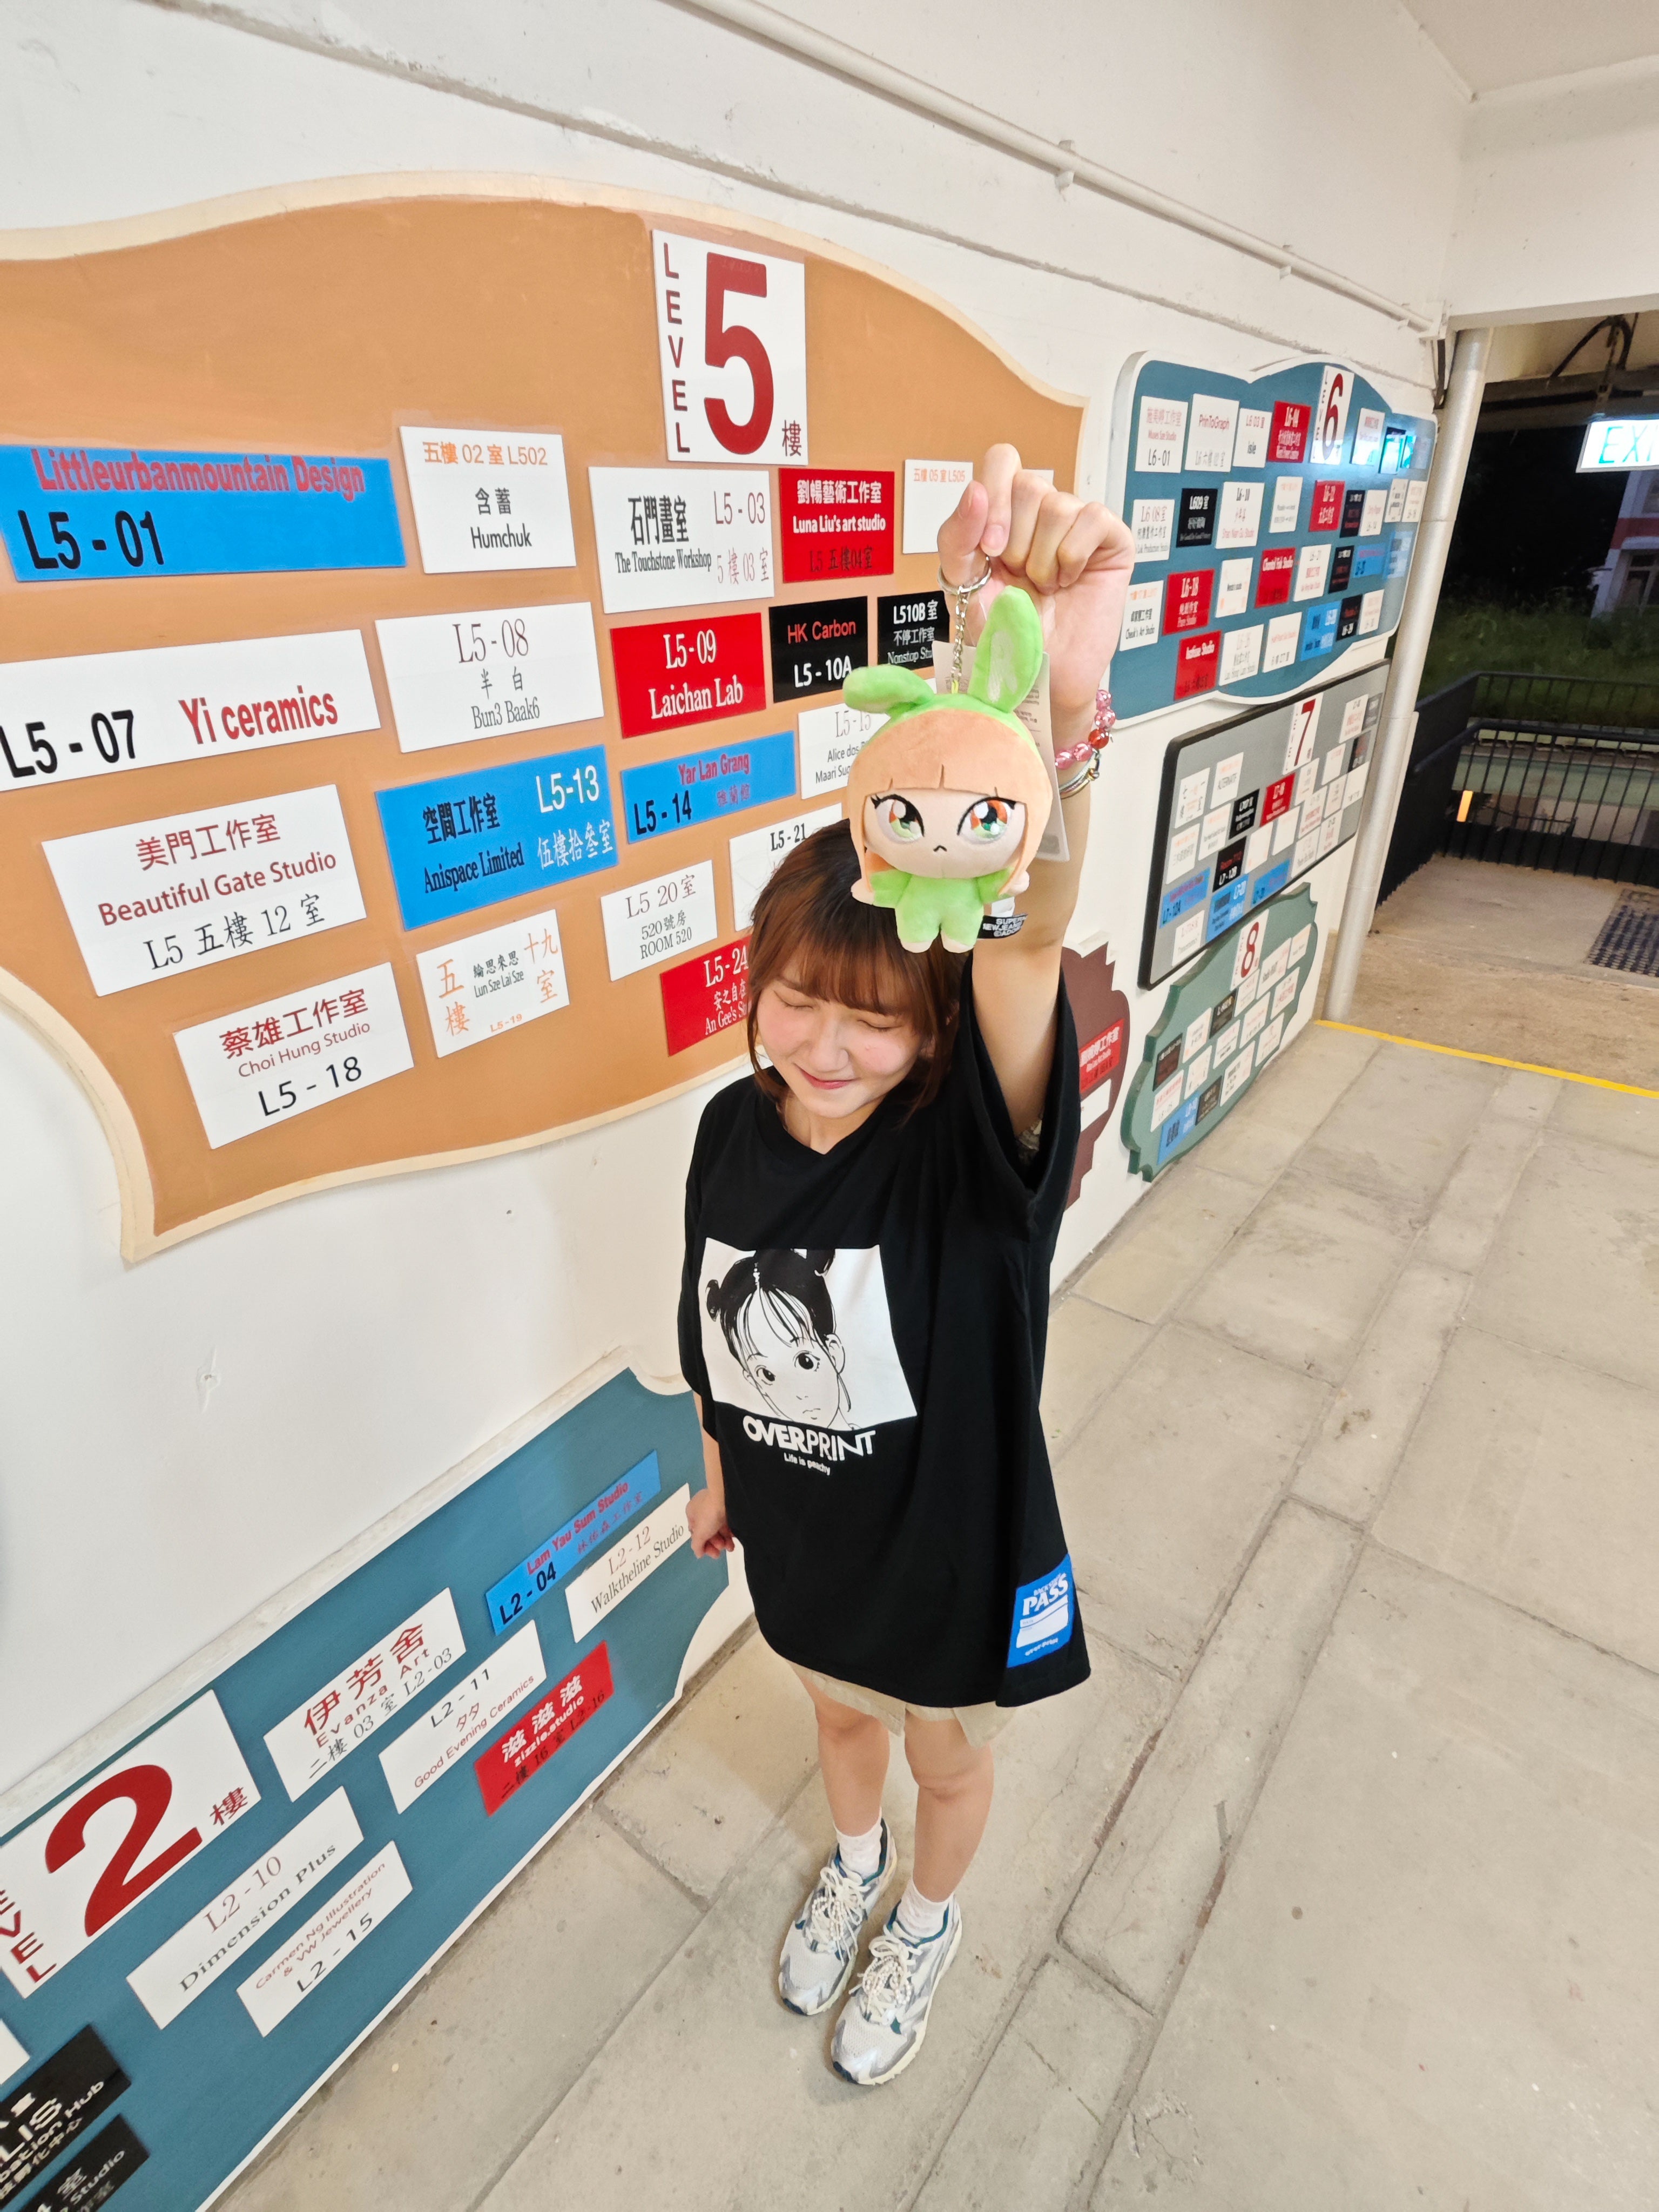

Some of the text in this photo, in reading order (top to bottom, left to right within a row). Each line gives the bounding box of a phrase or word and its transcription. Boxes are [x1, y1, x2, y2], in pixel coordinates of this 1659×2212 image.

[664, 242, 690, 453] LEVEL
[704, 252, 774, 455] 5
[782, 420, 802, 457] 樓
[1323, 373, 1344, 460] 6
[31, 449, 365, 501] Littleurbanmountain Design
[422, 441, 548, 466] 五樓 02 室 L502
[470, 523, 532, 550] Humchuk
[628, 495, 689, 545] 石門畫室
[793, 514, 886, 533] Luna Liu's art studio
[615, 548, 712, 573] The Touchstone Workshop
[787, 619, 856, 644] HK Carbon
[893, 626, 935, 646] 不停工作室
[887, 651, 919, 664] Nonstop
[178, 685, 338, 745] Yi ceramics
[471, 697, 539, 730] Bun3 Baak6
[649, 676, 743, 719] Laichan Lab
[827, 748, 845, 763] Alice
[1294, 698, 1316, 766] 7
[678, 753, 749, 785] Yar Lan Grang
[815, 766, 837, 784] Maari
[136, 814, 281, 871] 美門工作室
[422, 793, 500, 845] 空間工作室
[98, 852, 337, 926] Beautiful Gate Studio
[424, 842, 525, 894] Anispace Limited
[626, 892, 651, 919] L5
[143, 936, 183, 970] L5
[261, 906, 291, 936] 12
[300, 893, 325, 927] 室
[639, 927, 692, 960] ROOM 520
[1240, 921, 1259, 979] 8
[474, 970, 524, 998] Lun Sze Lai Sze
[219, 988, 369, 1060] 蔡雄工作室
[705, 1006, 737, 1035] An Gee's
[238, 1022, 370, 1078] Choi Hung Studio
[743, 1415, 876, 1461] OVERPRINT
[784, 1452, 831, 1476] Life is peachy
[527, 1482, 629, 1575] Lam Yau Sum Studio
[591, 1524, 684, 1615] Walktheline Studio
[1023, 1573, 1068, 1616] PASS
[316, 1648, 429, 1748] Evanza Art
[414, 1675, 534, 1788] Good Evening Ceramics
[210, 1787, 248, 1825] 樓
[45, 1764, 203, 1937] 2
[179, 1844, 336, 1992] Dimension Plus
[255, 1863, 385, 1990] Carmen Ng Illustration
[296, 1940, 317, 1964] VW
[320, 1887, 372, 1943] Jewellery
[65, 2081, 104, 2118] Hub
[70, 2150, 125, 2205] Studio
